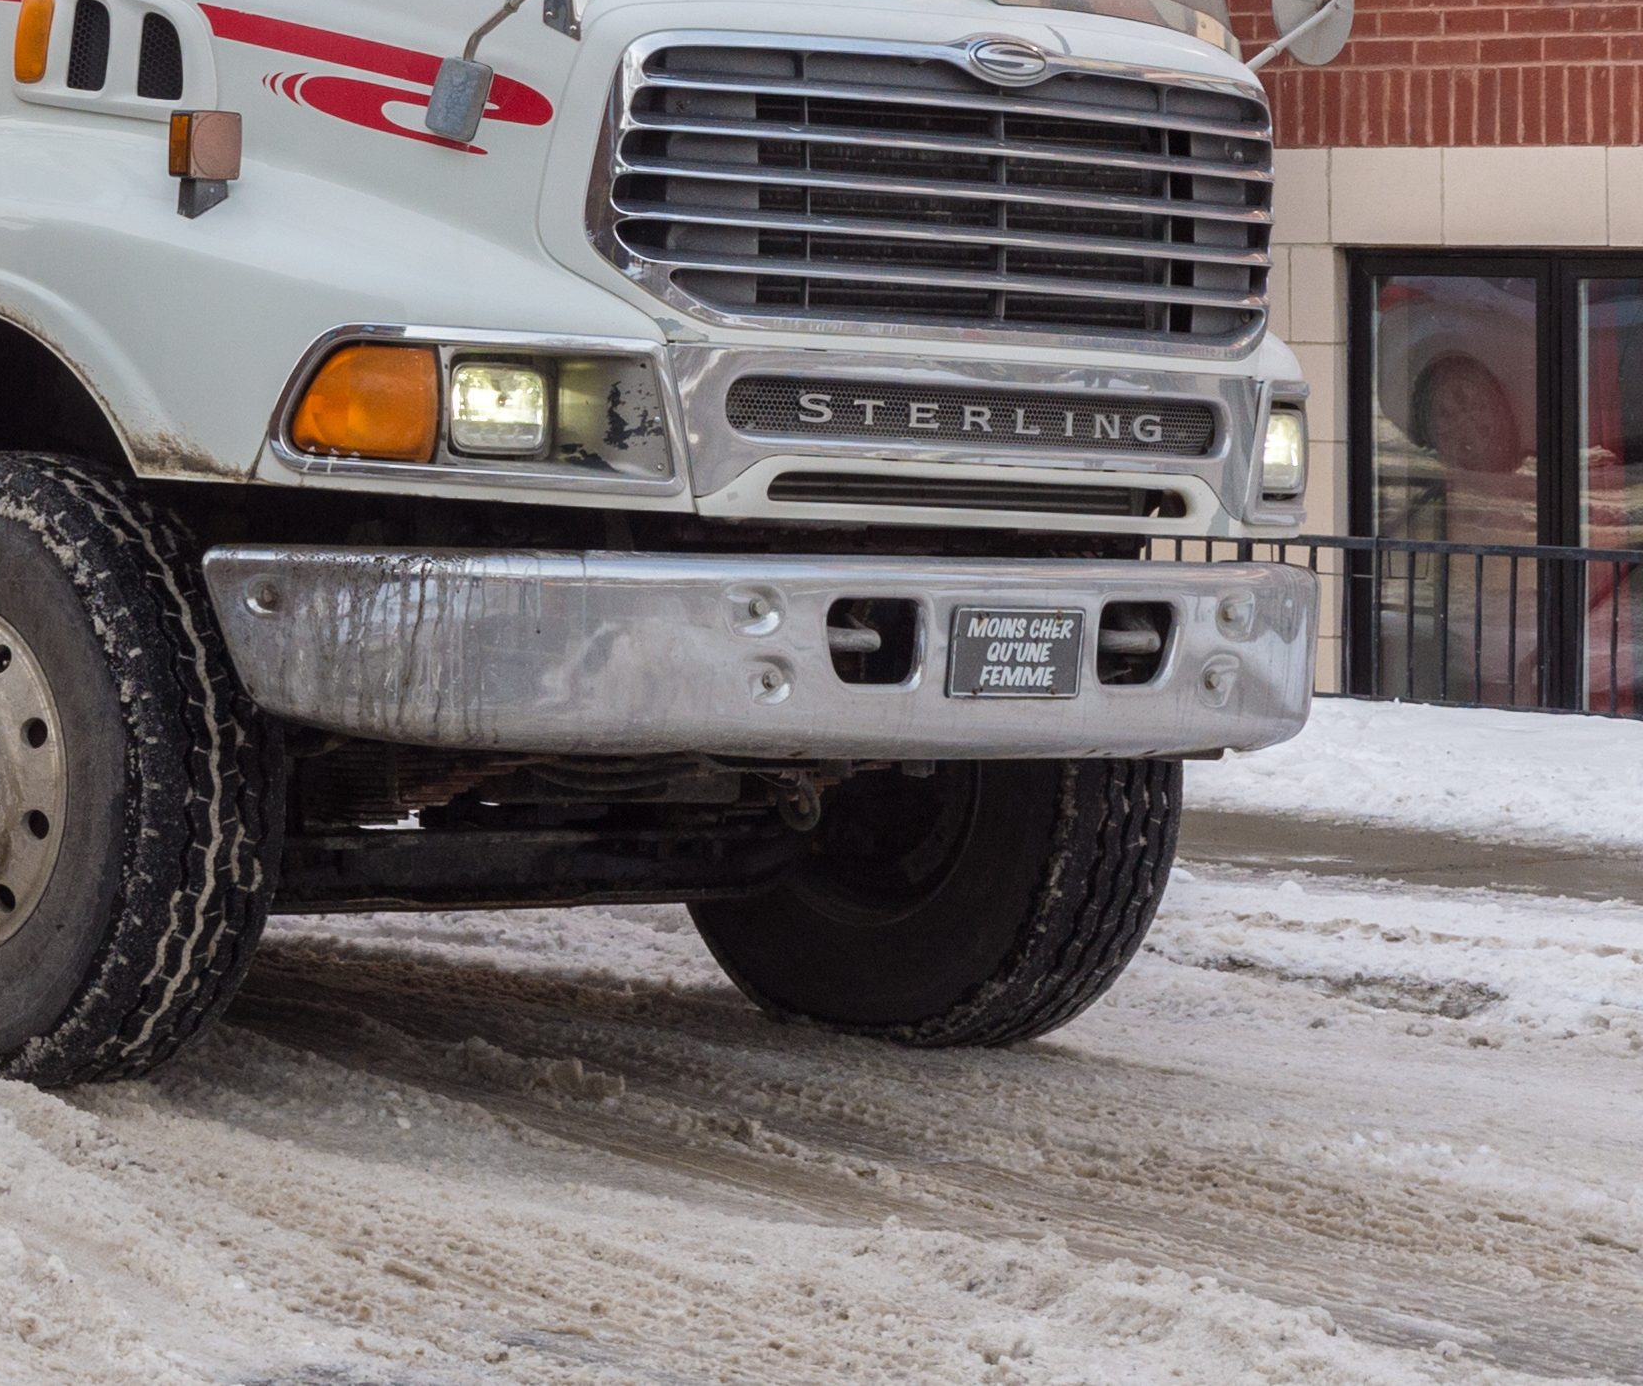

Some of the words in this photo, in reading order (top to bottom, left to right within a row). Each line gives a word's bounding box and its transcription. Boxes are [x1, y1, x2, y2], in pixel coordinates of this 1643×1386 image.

[798, 392, 1164, 443] STERLING
[967, 617, 1028, 638] MOINS
[1029, 618, 1075, 639] CHER
[986, 641, 1054, 663] QU'UNE
[979, 665, 1056, 687] FEMME
